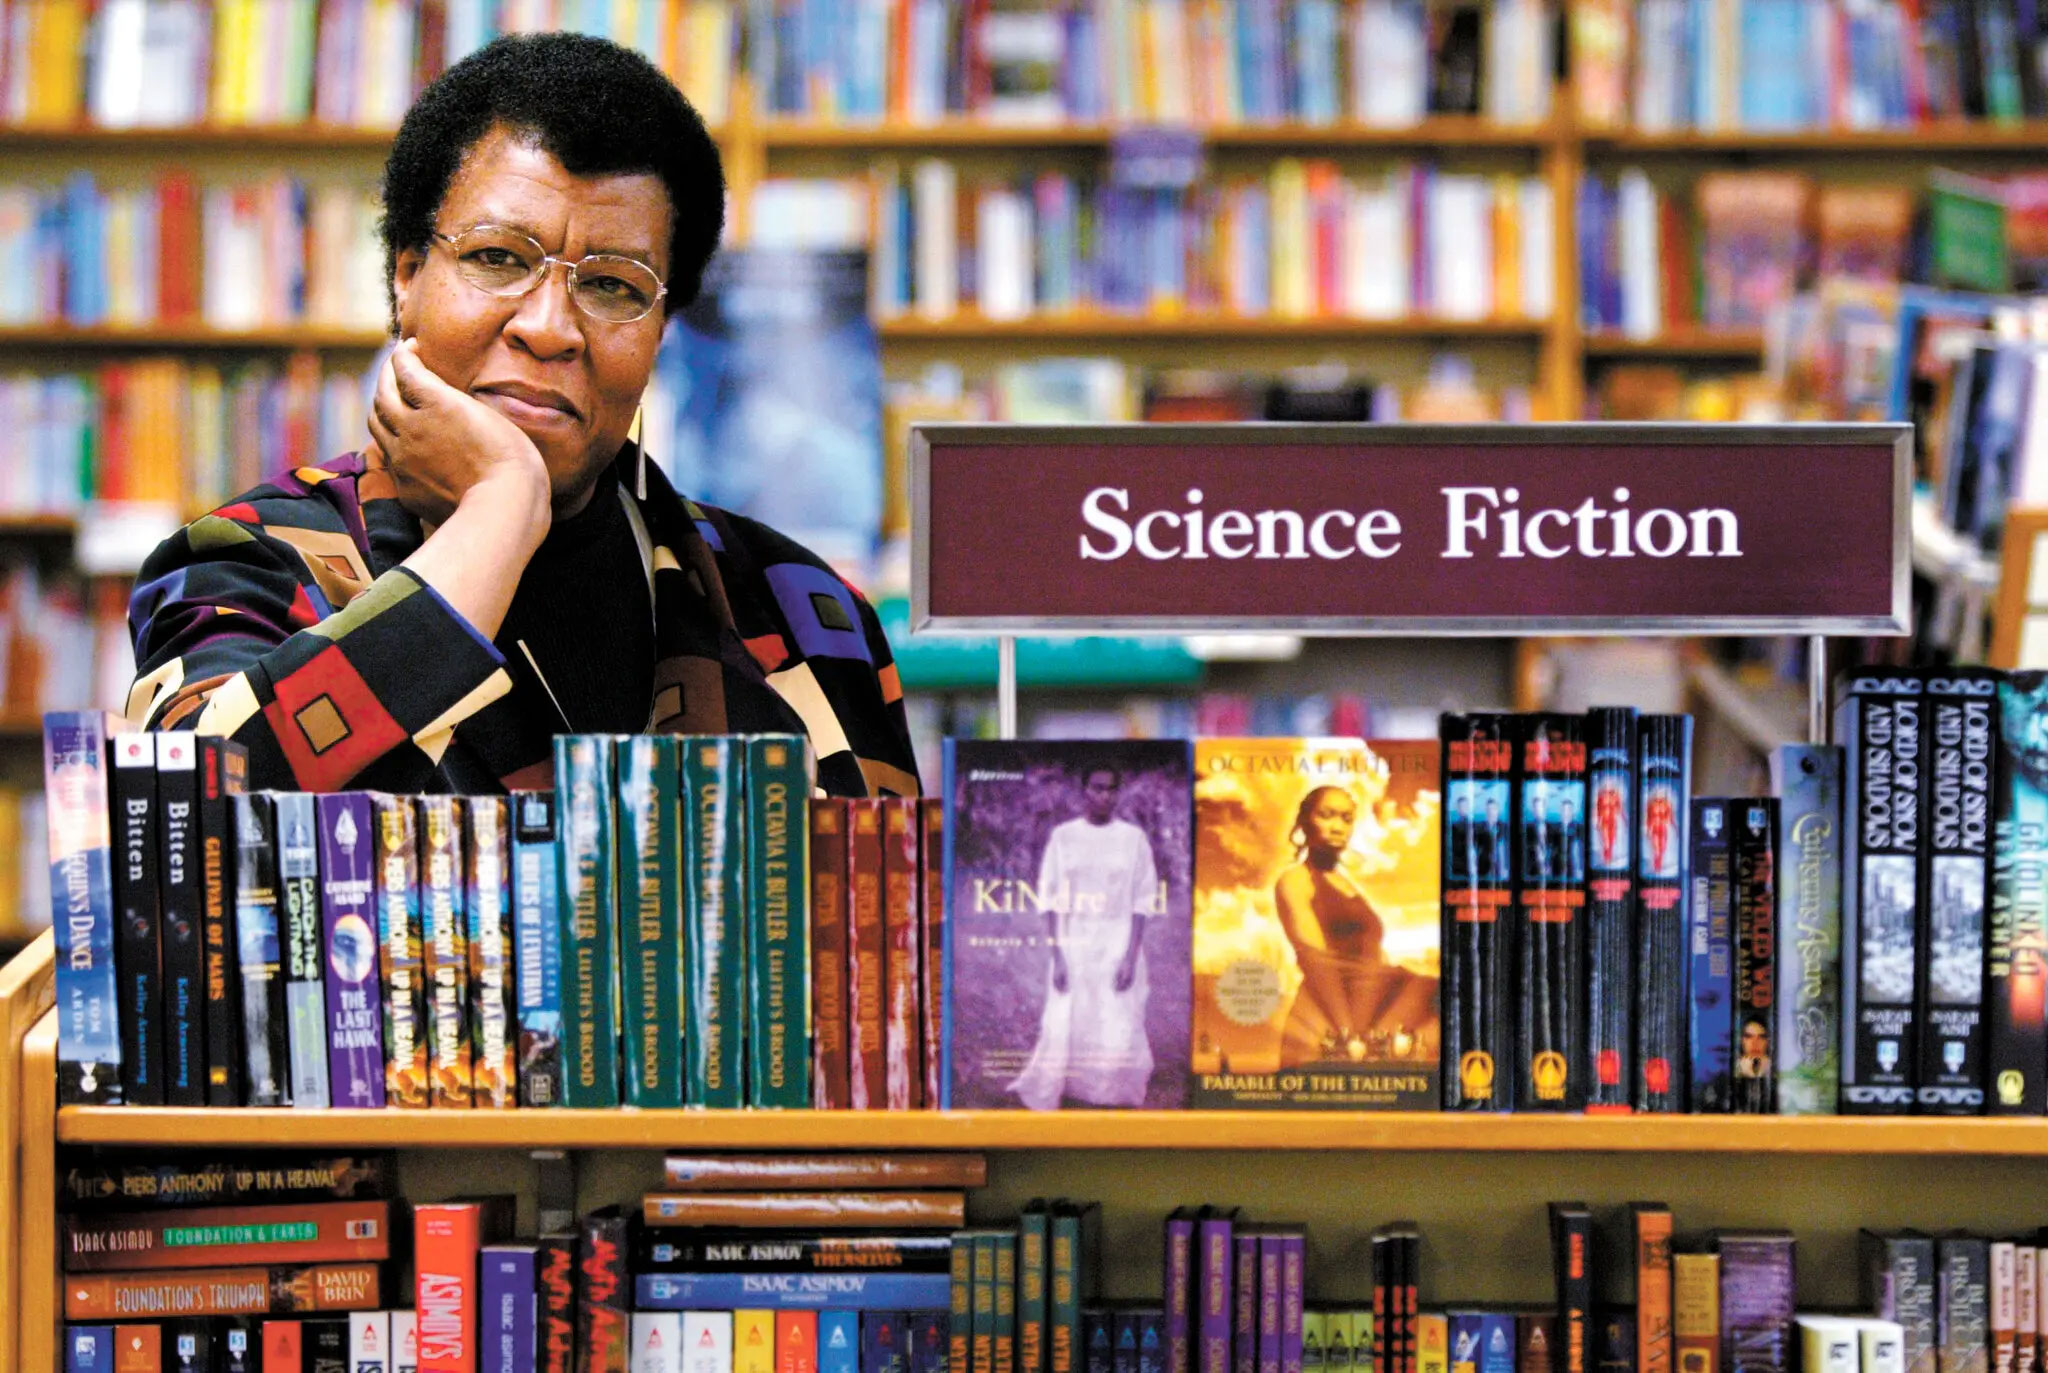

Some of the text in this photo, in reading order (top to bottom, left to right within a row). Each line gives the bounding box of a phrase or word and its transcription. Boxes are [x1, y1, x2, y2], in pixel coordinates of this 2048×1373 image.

[1079, 486, 1743, 562] Science Fiction
[1894, 701, 1919, 760] LORD
[1962, 701, 1989, 760] LORD
[1208, 755, 1310, 773] OCTAVIA
[1863, 703, 1892, 849] AND SHADOWS
[1932, 703, 1961, 849] AND SHADOWS
[127, 798, 148, 881] Bitten
[168, 801, 189, 884] Bitten
[765, 783, 787, 858] OCTAVIA
[1892, 791, 1917, 851] SNOW
[1960, 792, 1986, 852] SNOW
[1791, 812, 1832, 922] Catherine
[387, 892, 409, 960] ANTHONY
[434, 889, 455, 958] ANTHONY
[639, 877, 661, 942] BUTLER
[765, 876, 788, 942] BUTLER
[1740, 857, 1752, 940] CATHERINE
[1989, 821, 2014, 977] NEAL ASHER
[69, 915, 96, 971] DANCE
[208, 923, 223, 946] OF
[287, 881, 303, 978] LIGHTNING
[1751, 851, 1772, 1009] THE VEILED WEB
[1797, 920, 1829, 998] Asaro
[208, 952, 225, 1001] MARS
[391, 969, 410, 989] UP
[436, 967, 456, 987] UP
[482, 967, 501, 987] UP
[522, 928, 543, 1008] LEVIATHAN
[71, 986, 85, 1045] ARDEN
[89, 996, 101, 1034] TOM
[336, 1009, 373, 1029] LAST
[339, 991, 367, 1009] THE
[769, 949, 785, 1088] LILITH'S BROOD
[334, 1028, 377, 1049] HAWK
[580, 1021, 595, 1086] BROOD
[643, 1023, 659, 1088] BROOD
[706, 1023, 721, 1089] BROOD
[1202, 1074, 1429, 1093] PARABLE OF THE TALENTS
[123, 1176, 157, 1195] PIERS
[160, 1173, 226, 1194] ANTHONY
[236, 1172, 253, 1190] UP
[256, 1171, 271, 1189] IN
[273, 1170, 286, 1188] A
[73, 1230, 154, 1253] ISAAC ASIMOV
[165, 1226, 253, 1246] FOUNDATION
[257, 1227, 266, 1241] &
[705, 1244, 803, 1262] ISAAC ASIMOV
[114, 1283, 266, 1313] FOUNDATION'S TRIUMPH
[317, 1271, 371, 1288] DAVID
[323, 1285, 365, 1302] BRIN
[741, 1275, 867, 1293] ISAAC ASIMOV
